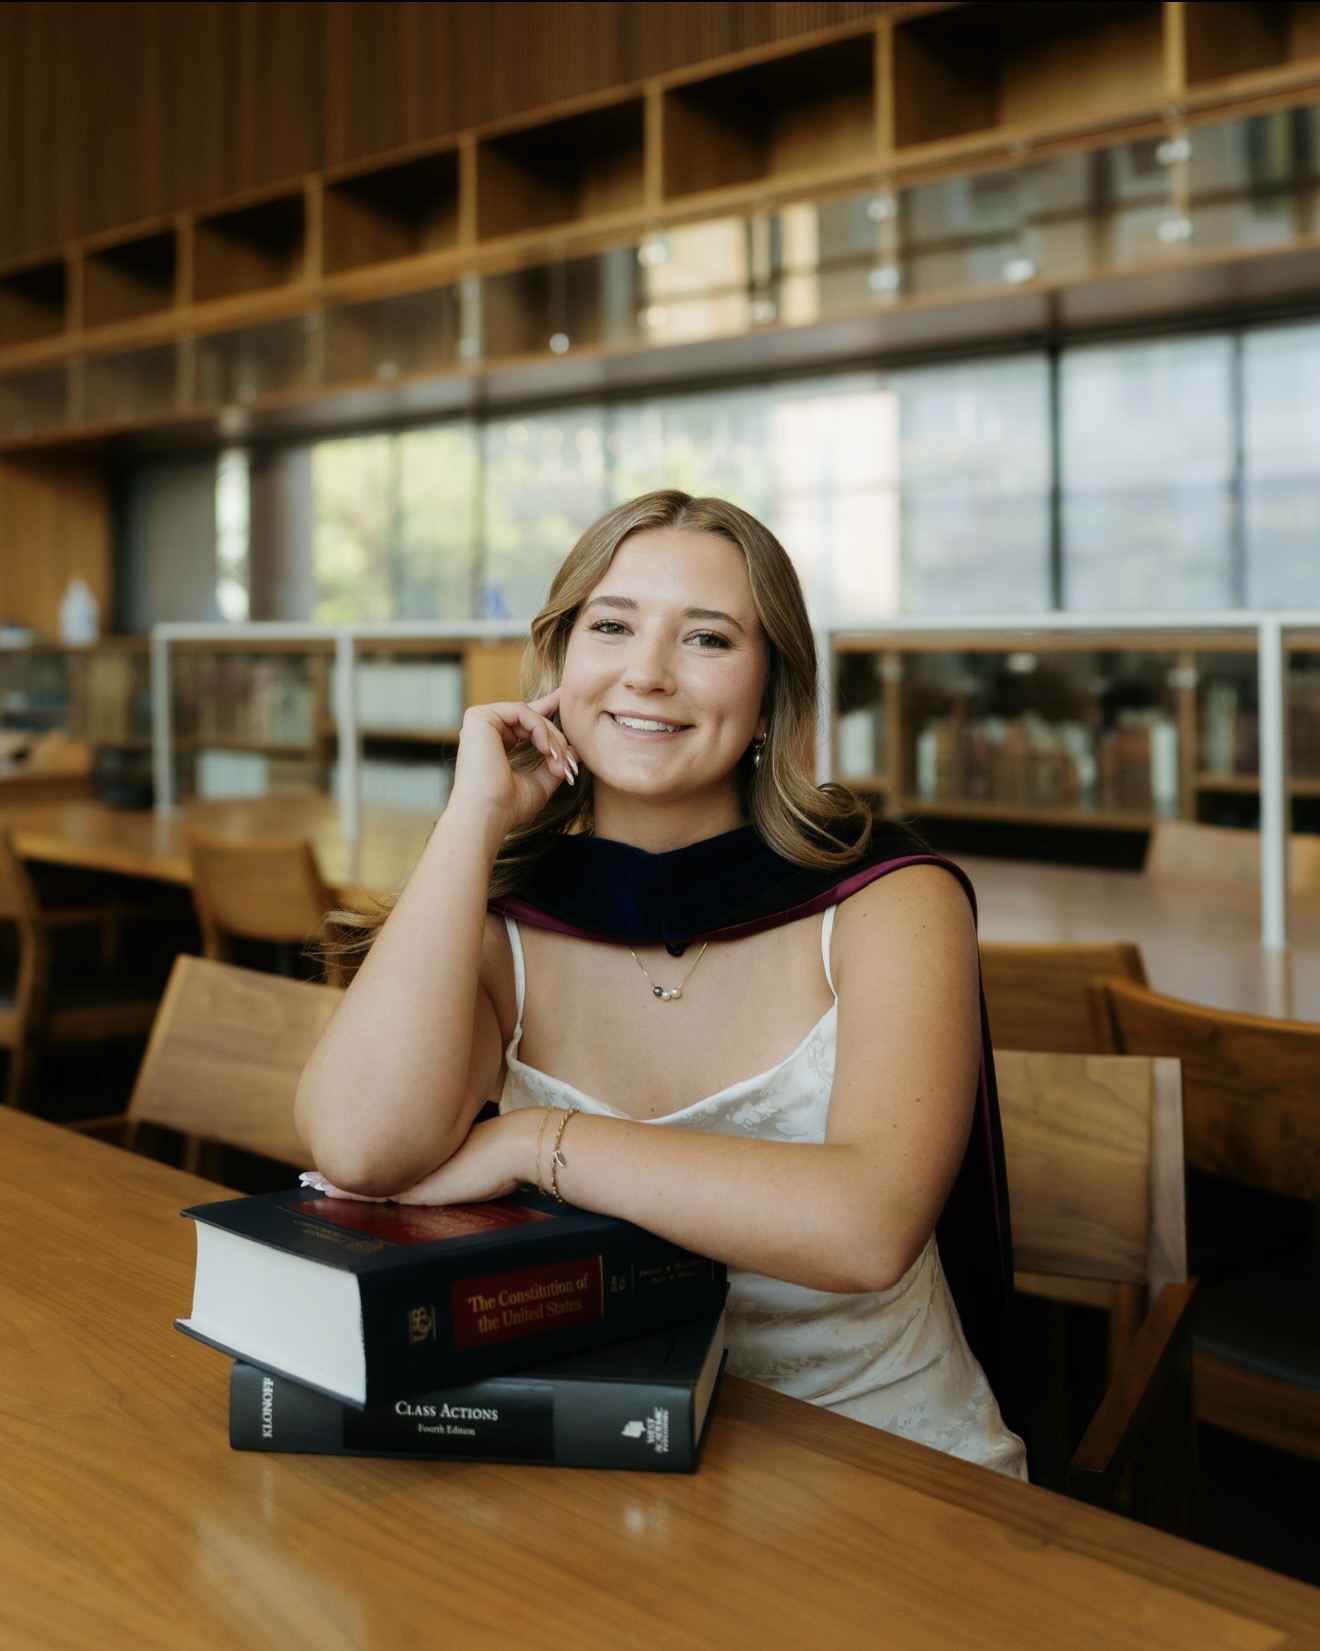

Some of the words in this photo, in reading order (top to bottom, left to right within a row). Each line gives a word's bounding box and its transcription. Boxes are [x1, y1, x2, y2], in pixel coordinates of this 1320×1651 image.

[468, 1294, 496, 1313] The
[498, 1279, 574, 1307] Constitution
[576, 1273, 589, 1290] of
[478, 1315, 499, 1333] the
[503, 1304, 544, 1326] United
[547, 1299, 583, 1317] States
[262, 1377, 274, 1438] KLONOFF
[418, 1423, 445, 1434] Fourth
[446, 1425, 476, 1436] Edition
[646, 1416, 655, 1444] WEST
